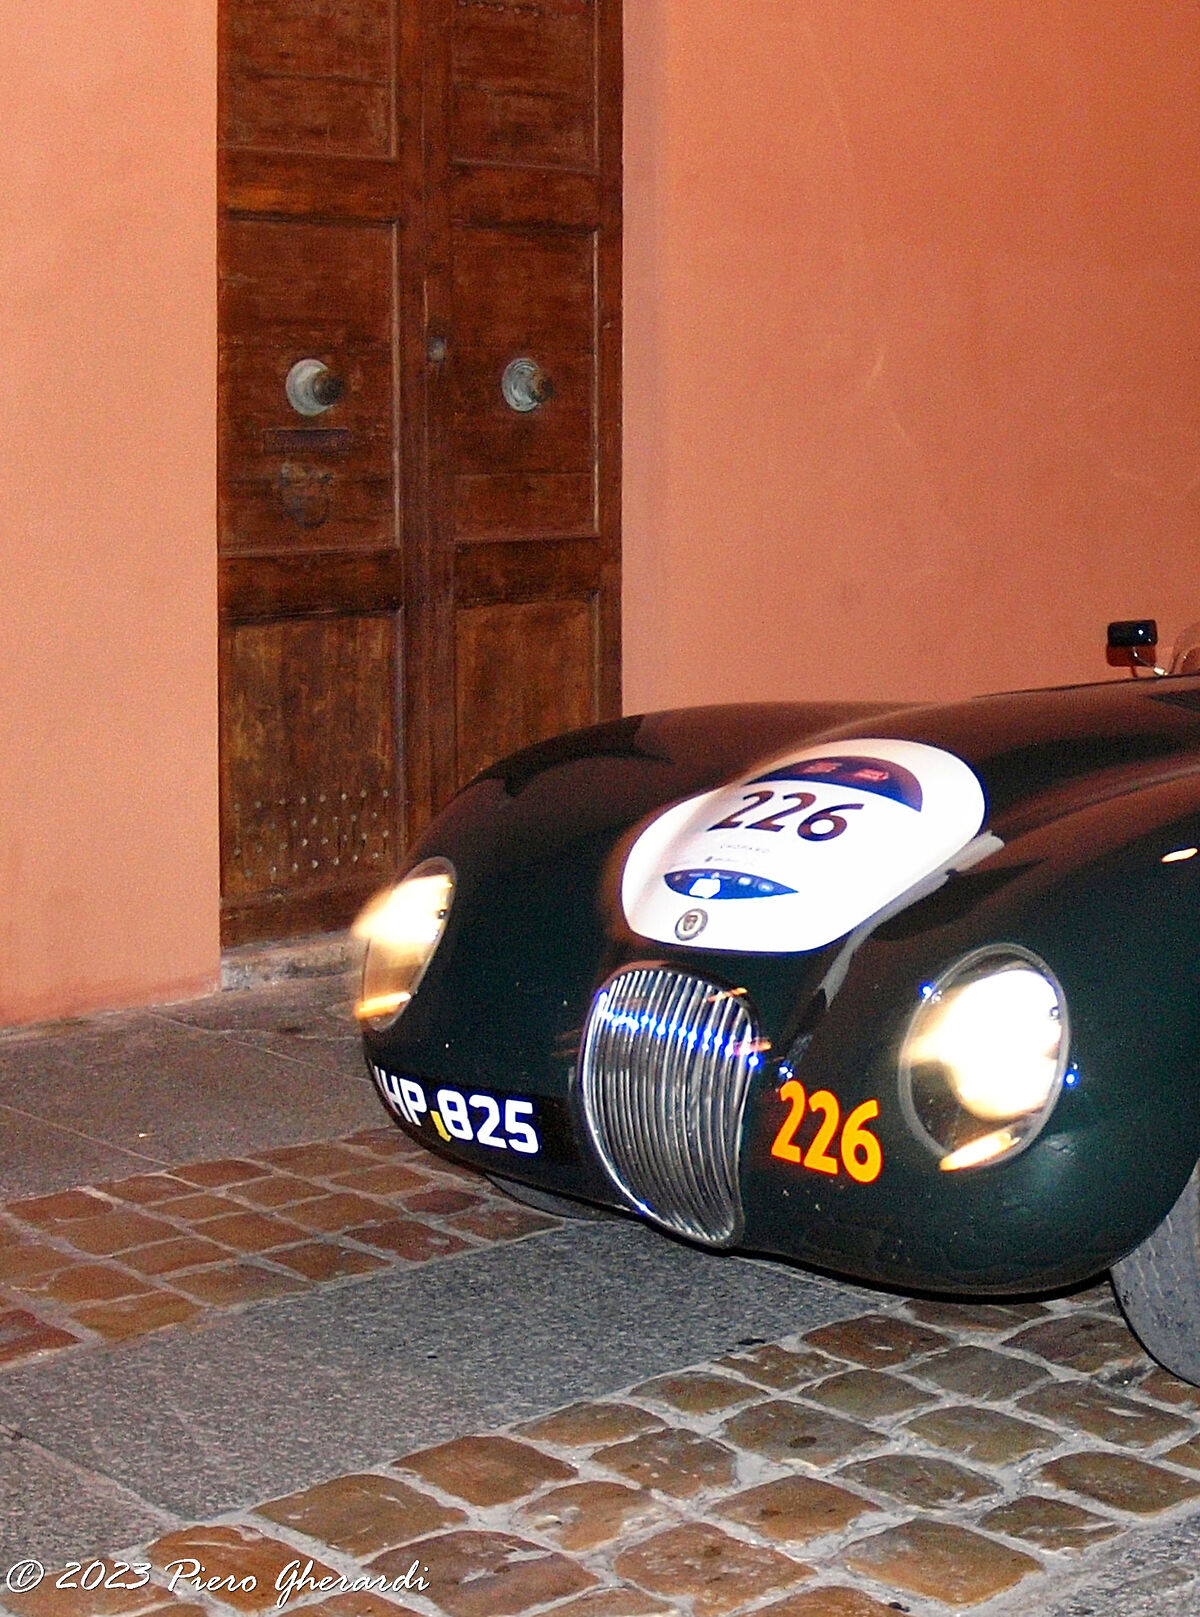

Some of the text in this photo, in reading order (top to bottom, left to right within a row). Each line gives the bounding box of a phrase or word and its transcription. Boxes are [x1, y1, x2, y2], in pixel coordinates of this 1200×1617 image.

[706, 790, 864, 842] 226
[373, 1065, 539, 1154] HP 825
[771, 1079, 883, 1184] 226
